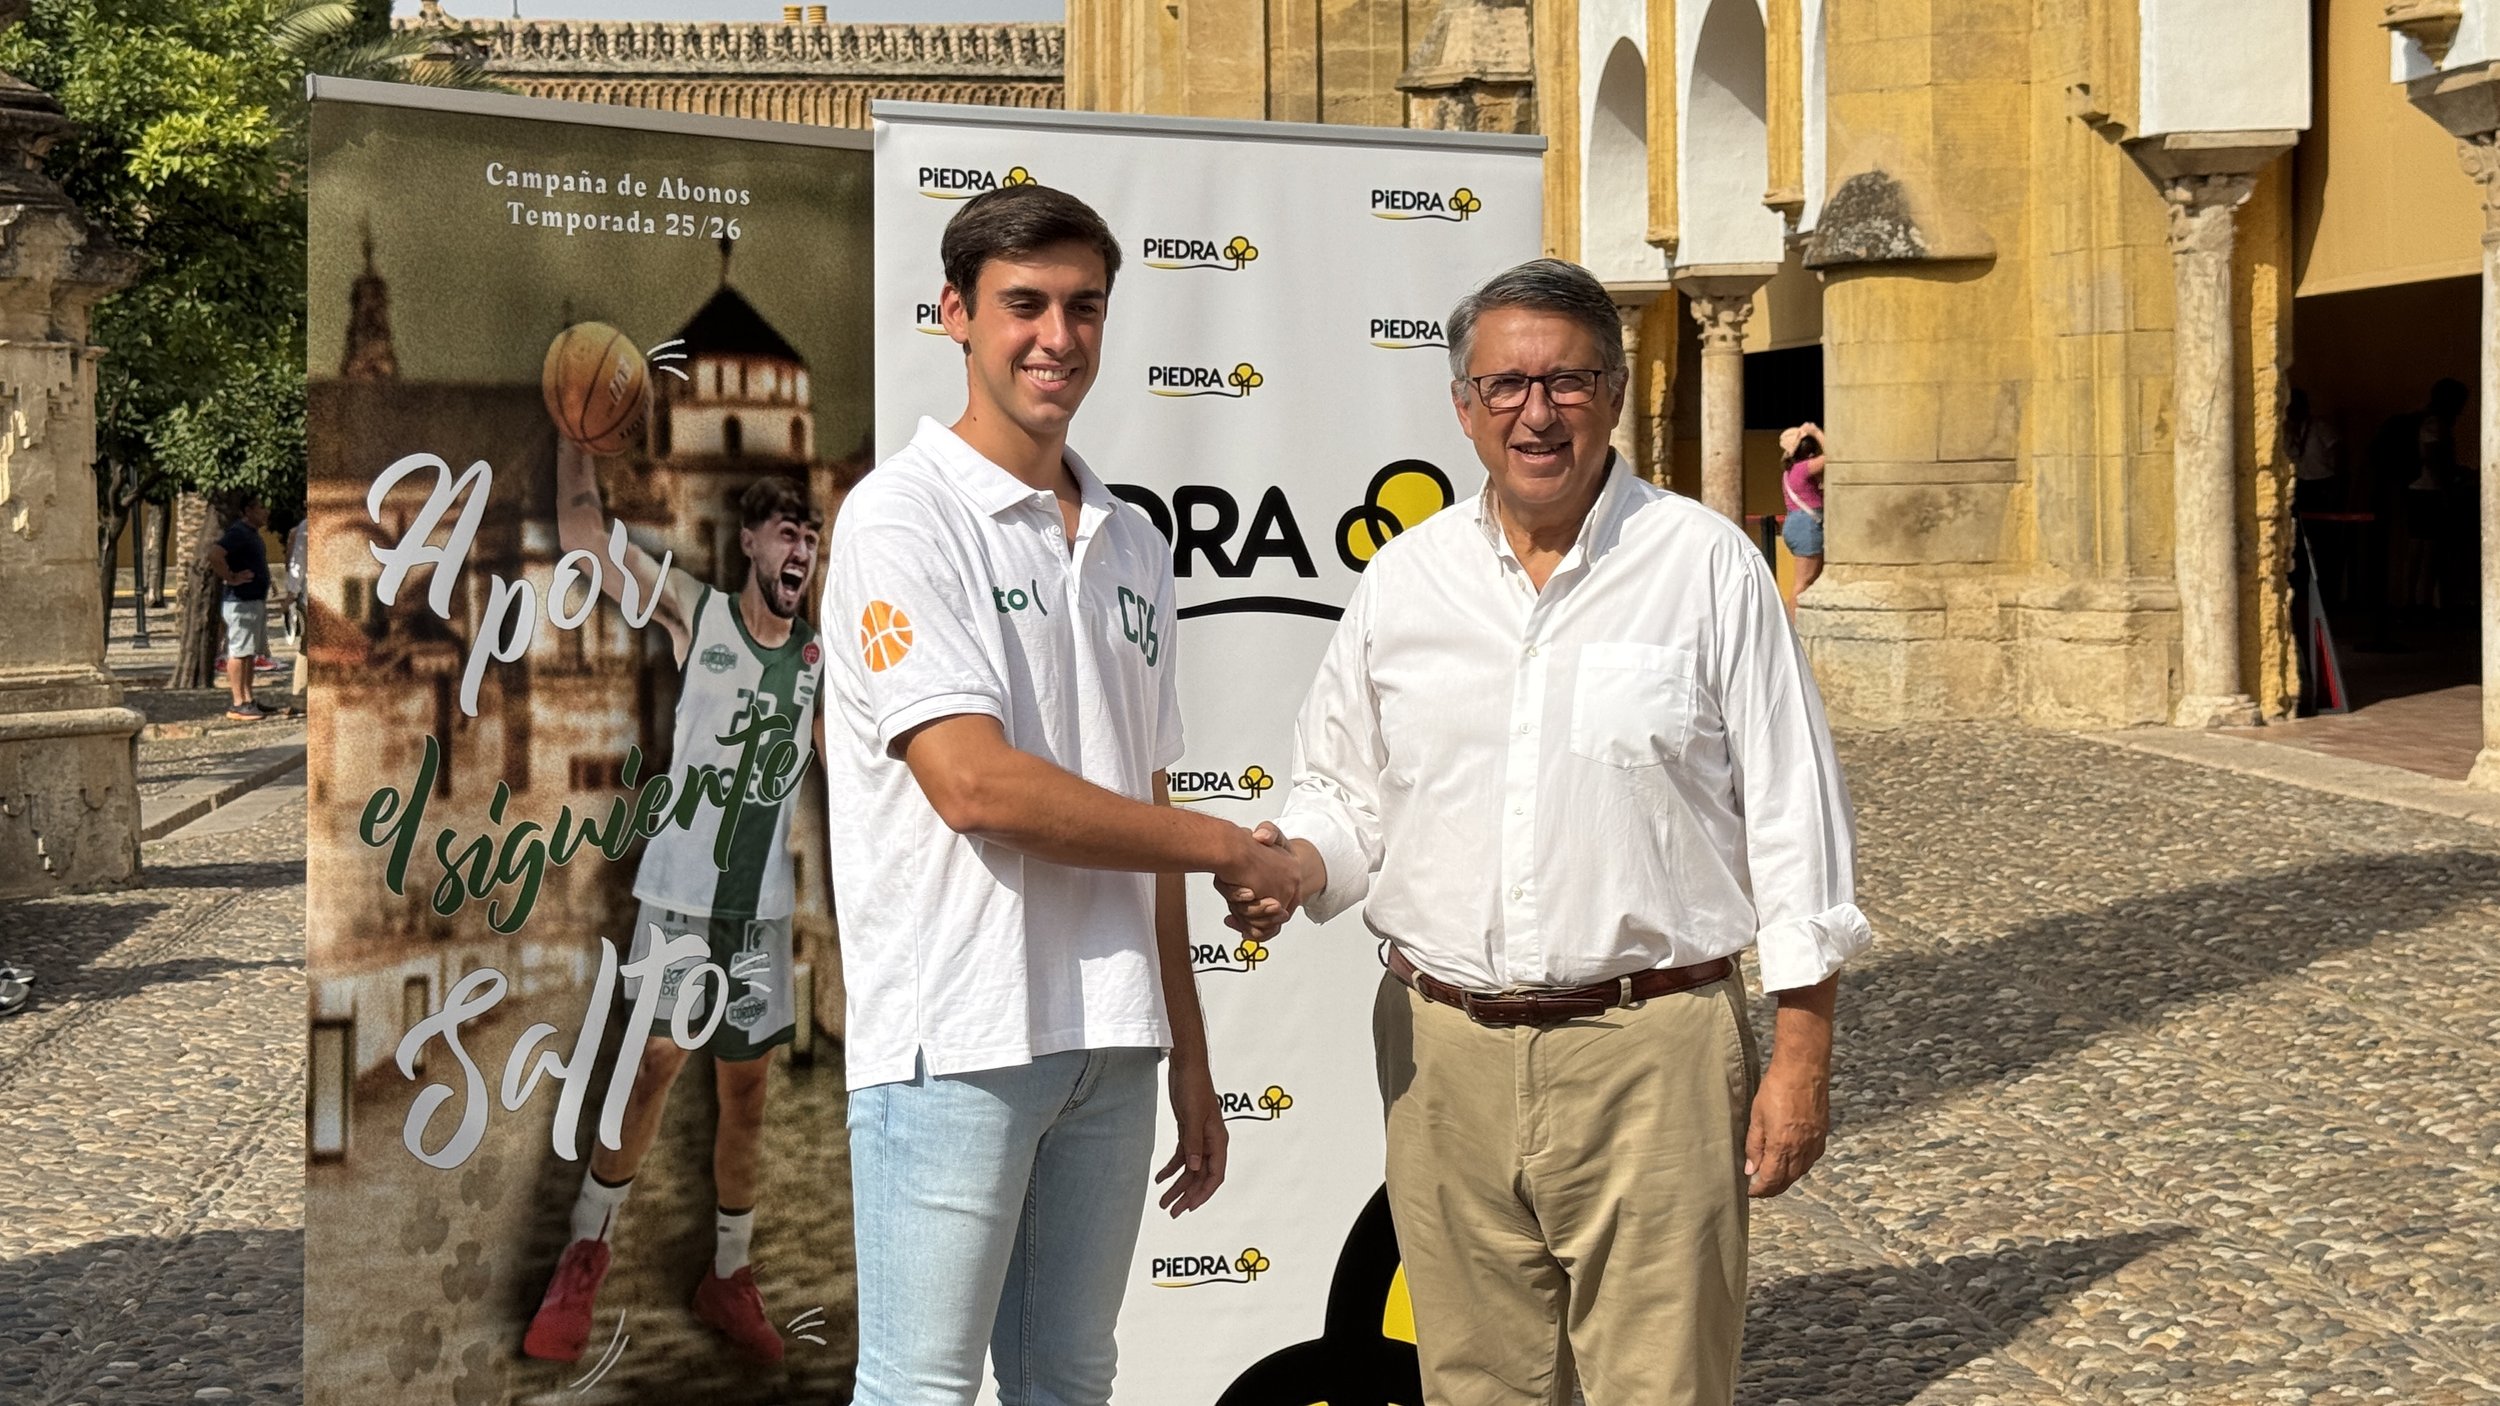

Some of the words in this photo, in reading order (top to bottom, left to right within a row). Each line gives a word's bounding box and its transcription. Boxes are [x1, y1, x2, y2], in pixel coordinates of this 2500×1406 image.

[486, 162, 607, 197] Campaña
[617, 173, 647, 197] de
[657, 177, 750, 205] Abonos
[507, 201, 655, 235] Temporada
[665, 214, 741, 240] 25/26
[367, 453, 493, 619] A
[460, 518, 673, 717] por
[1103, 484, 1318, 578] DRA
[359, 735, 440, 896] el
[433, 704, 815, 934] siguiente
[396, 922, 729, 1169] Salto
